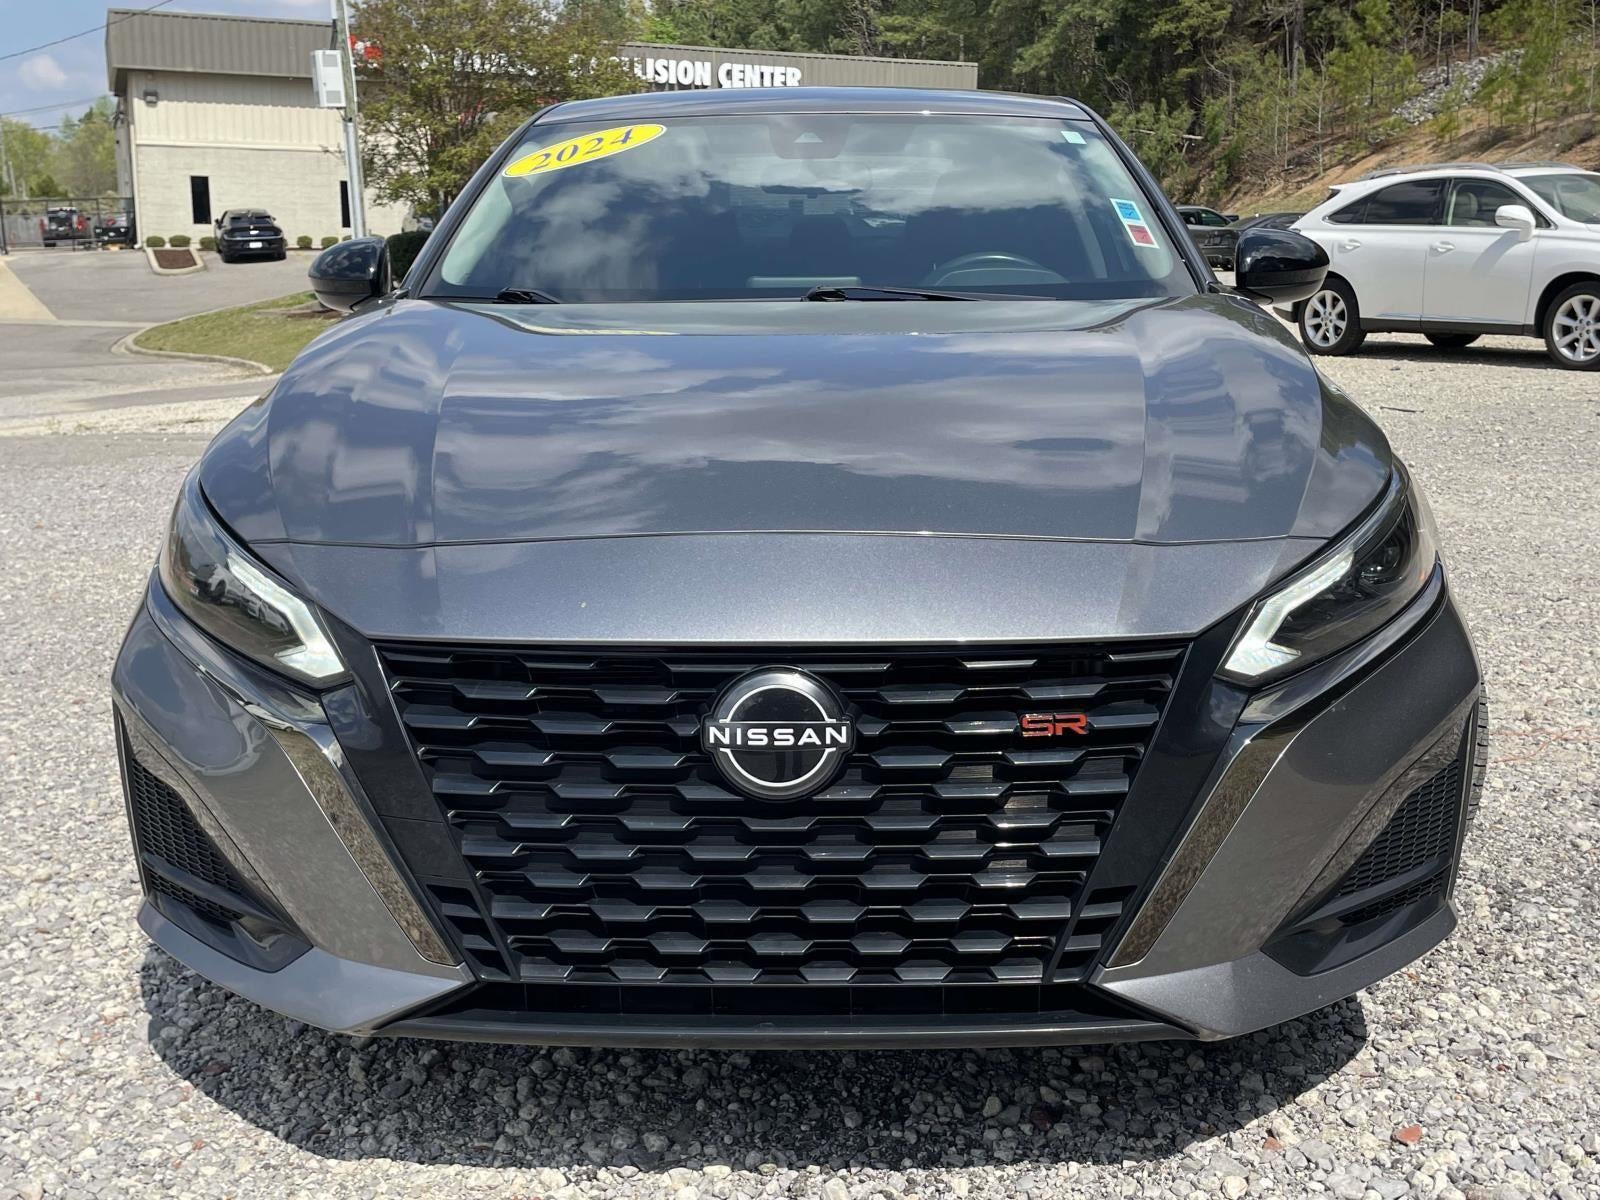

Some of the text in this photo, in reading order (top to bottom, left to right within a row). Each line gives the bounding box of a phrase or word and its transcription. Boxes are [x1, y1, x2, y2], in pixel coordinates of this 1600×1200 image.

[608, 57, 801, 88] LISION CENTER
[529, 128, 634, 172] 2024
[709, 725, 847, 746] NISSAN
[1019, 713, 1088, 737] SR
